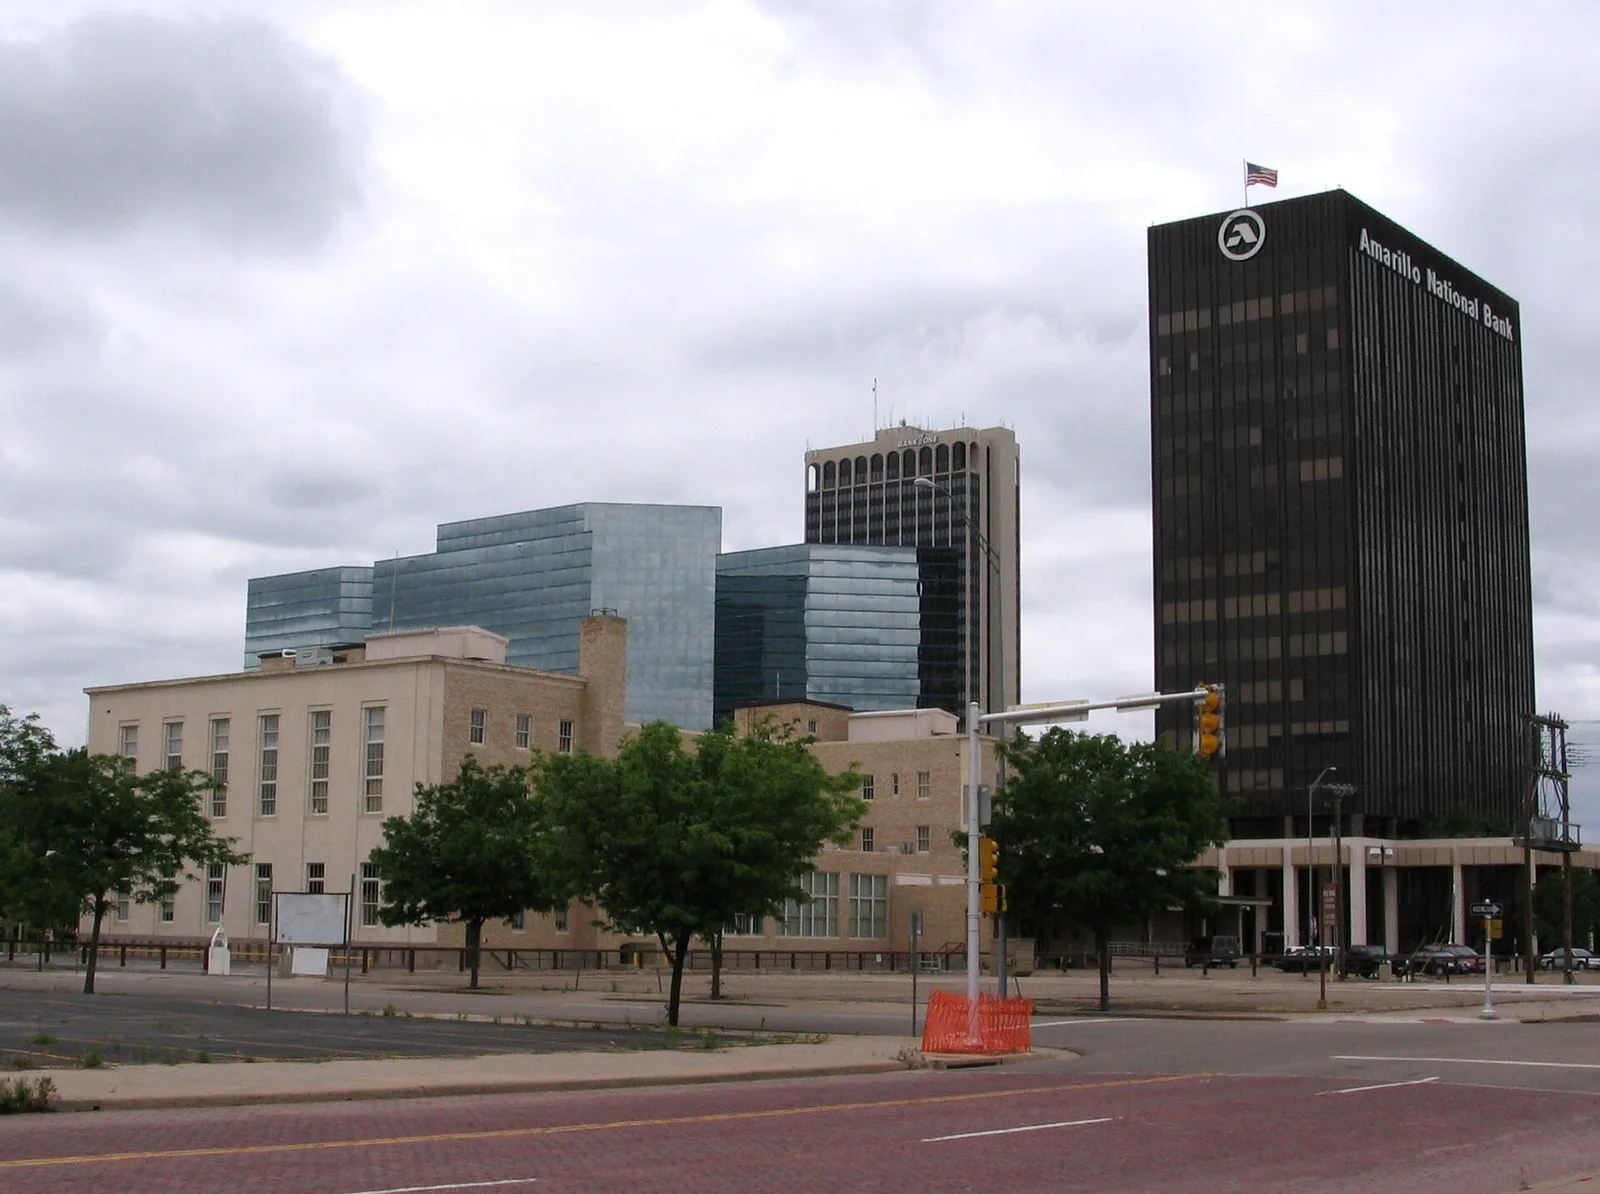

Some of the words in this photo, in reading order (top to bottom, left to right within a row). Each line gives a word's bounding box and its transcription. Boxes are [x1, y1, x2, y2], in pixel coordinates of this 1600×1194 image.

[1359, 227, 1421, 284] Amarillo
[1426, 268, 1479, 320] National
[1483, 303, 1513, 341] Bank
